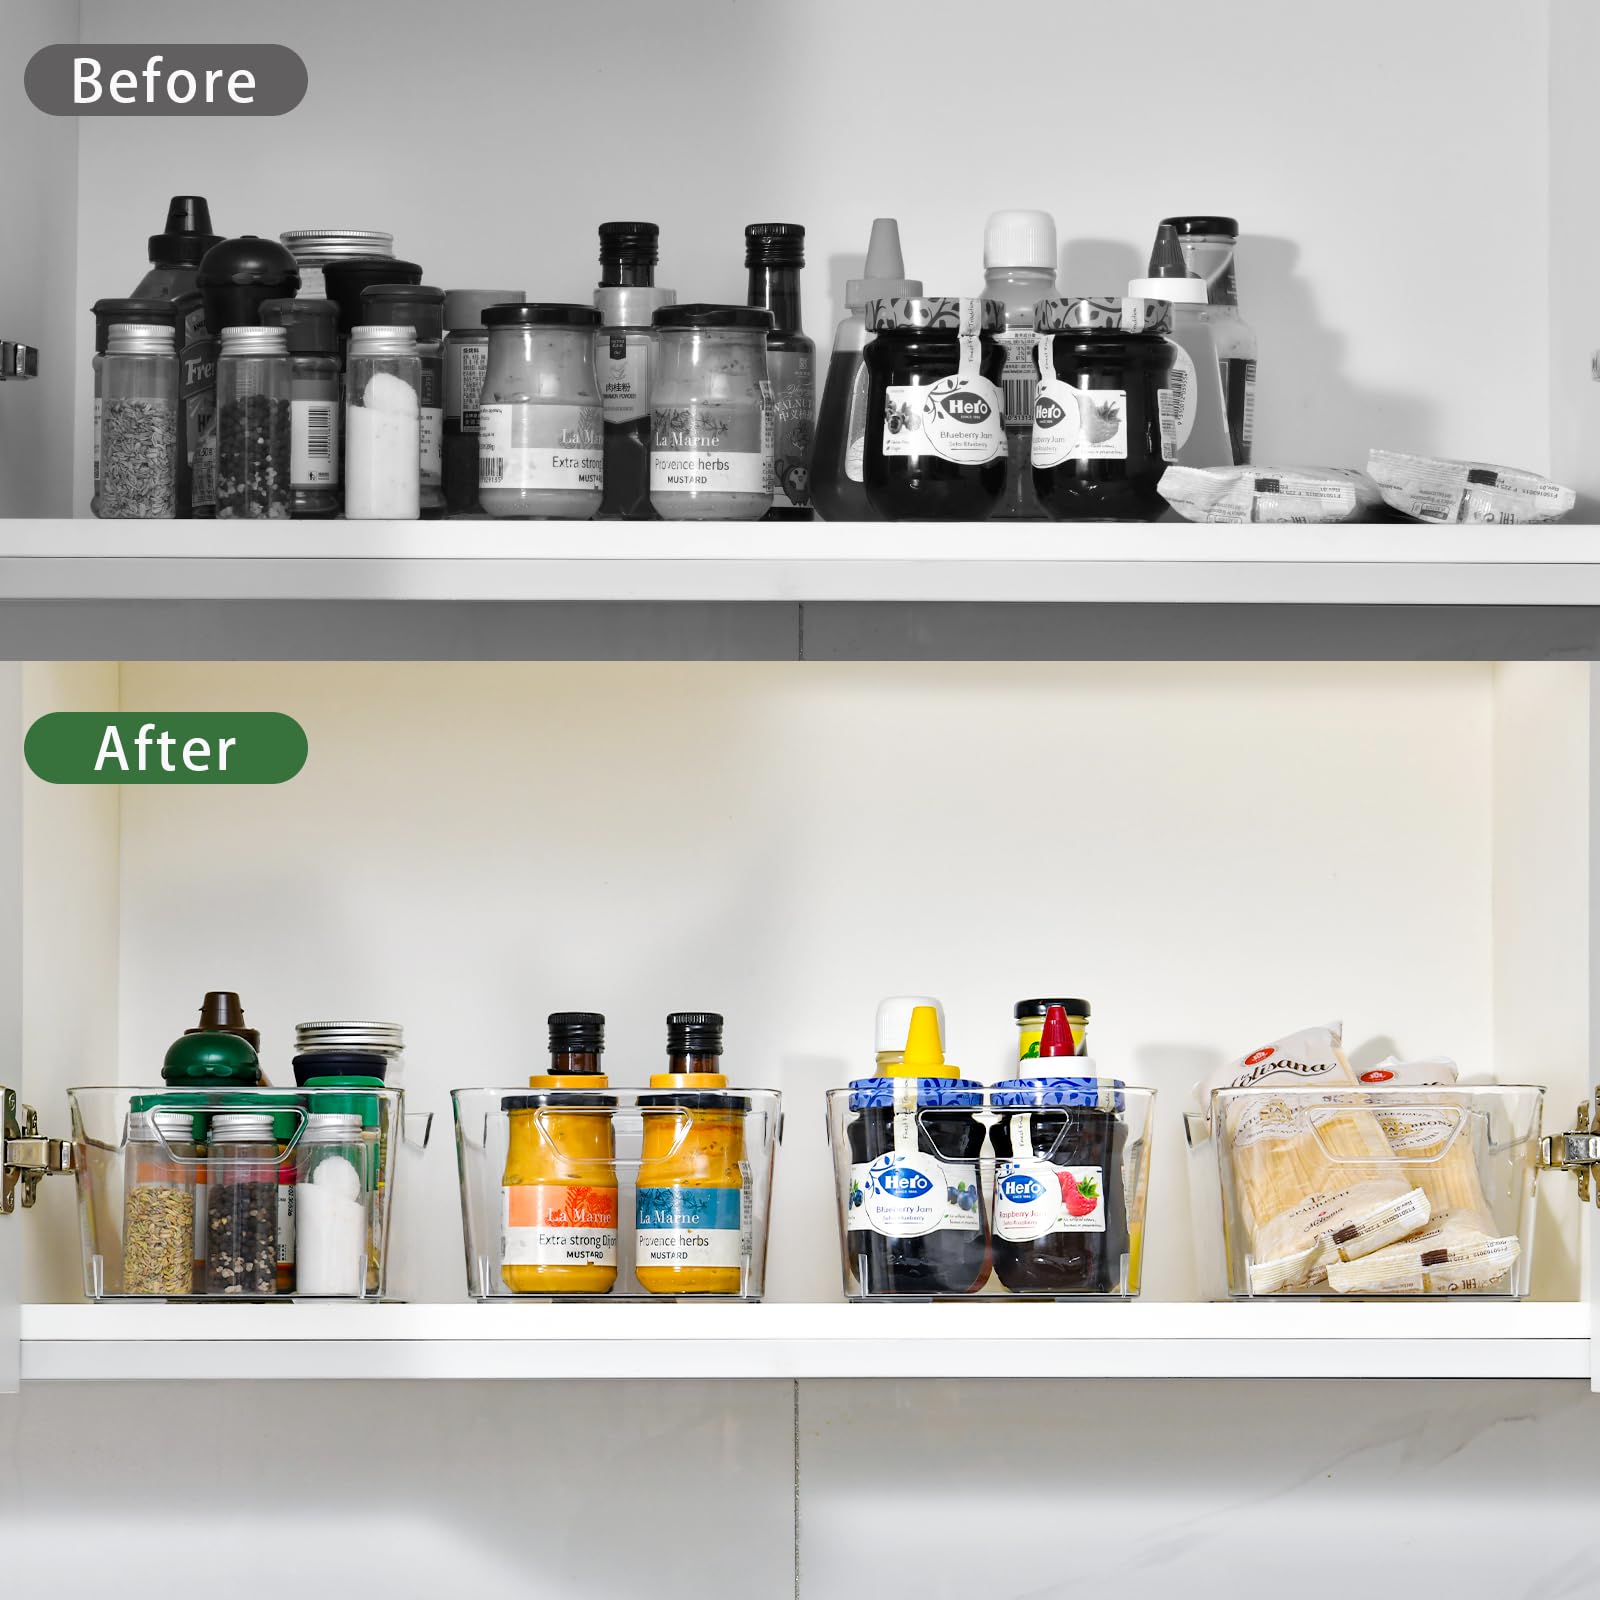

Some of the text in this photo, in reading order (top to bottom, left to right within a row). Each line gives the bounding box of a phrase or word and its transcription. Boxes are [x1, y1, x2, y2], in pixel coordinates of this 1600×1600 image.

[605, 382, 631, 393] 肉桂粉
[949, 399, 988, 415] Hero
[1036, 404, 1061, 419] Hero
[560, 428, 579, 444] La
[656, 431, 720, 447] La Marne
[940, 431, 979, 440] Blueberry
[552, 455, 579, 468] Extra
[655, 457, 730, 471] Provence herbs
[667, 475, 708, 484] MUSTARD
[884, 1174, 928, 1189] Hero
[1005, 1180, 1041, 1194] Hero
[548, 1207, 612, 1223] La Marne
[876, 1205, 933, 1214] Blueerry Jam
[640, 1209, 700, 1225] La Marne
[539, 1233, 567, 1246] Extra
[569, 1235, 601, 1250] strong
[639, 1234, 709, 1247] Provence herbs
[566, 1250, 604, 1259] MUSTARD
[650, 1251, 688, 1260] MUSTARD
